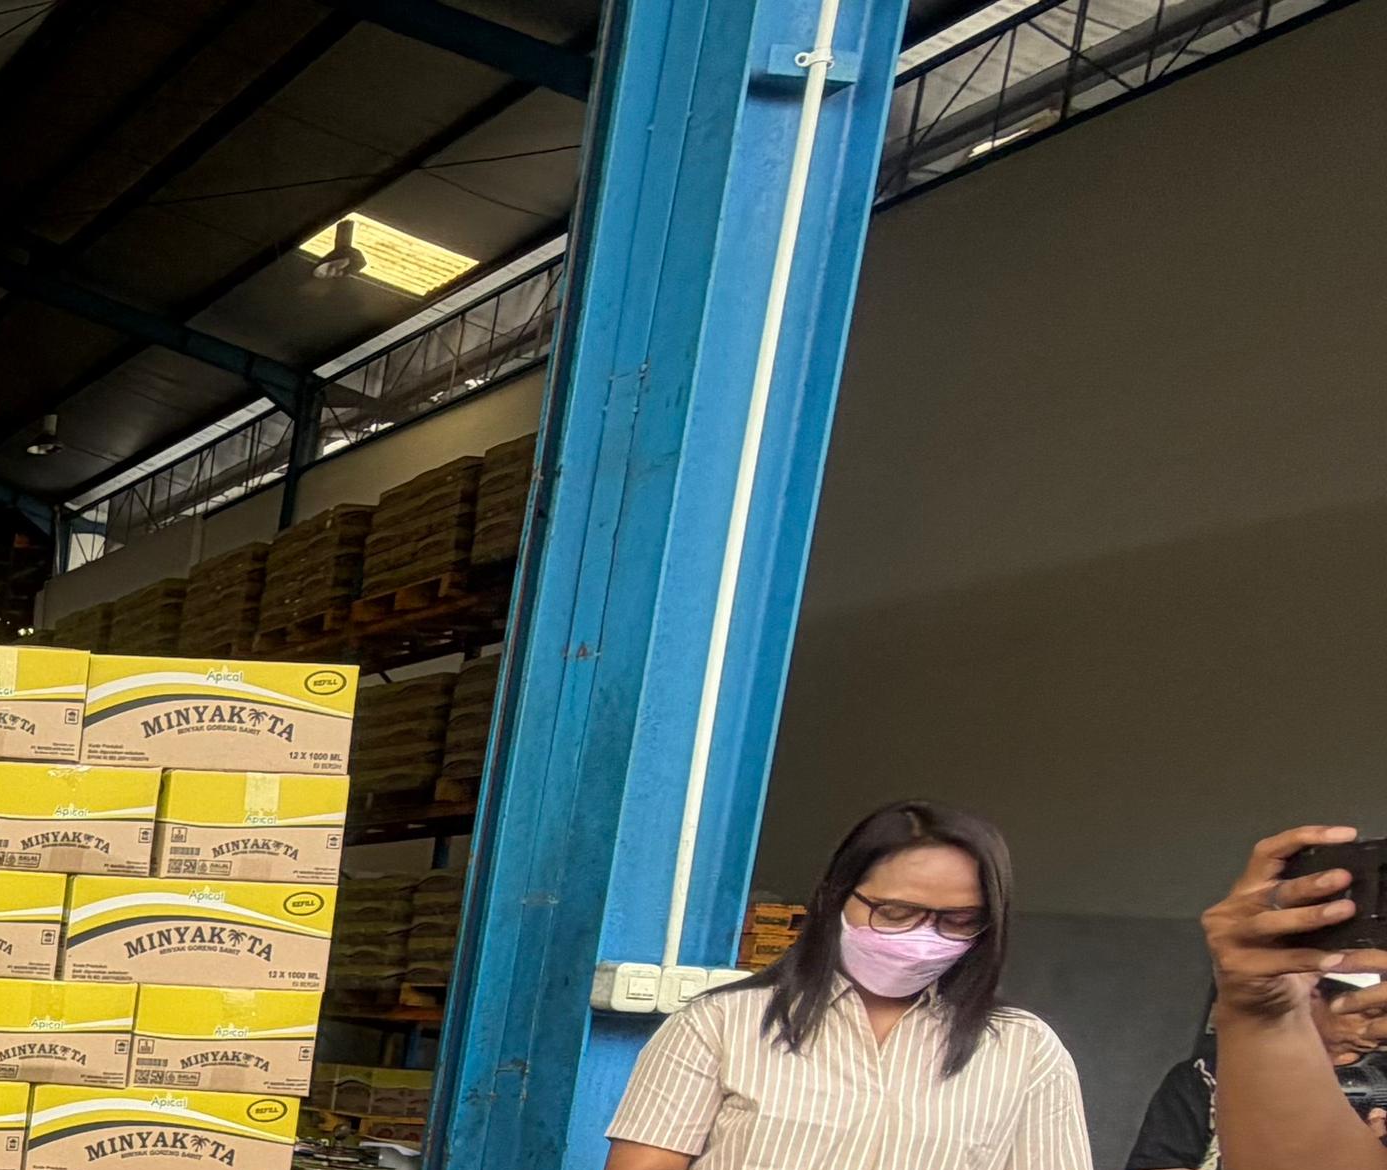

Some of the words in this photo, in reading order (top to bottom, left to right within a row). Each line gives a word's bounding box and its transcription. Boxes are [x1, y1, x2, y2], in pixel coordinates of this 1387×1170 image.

[313, 679, 338, 687] REFILL
[291, 899, 316, 908] REFILL
[255, 1106, 279, 1115] REFILL
